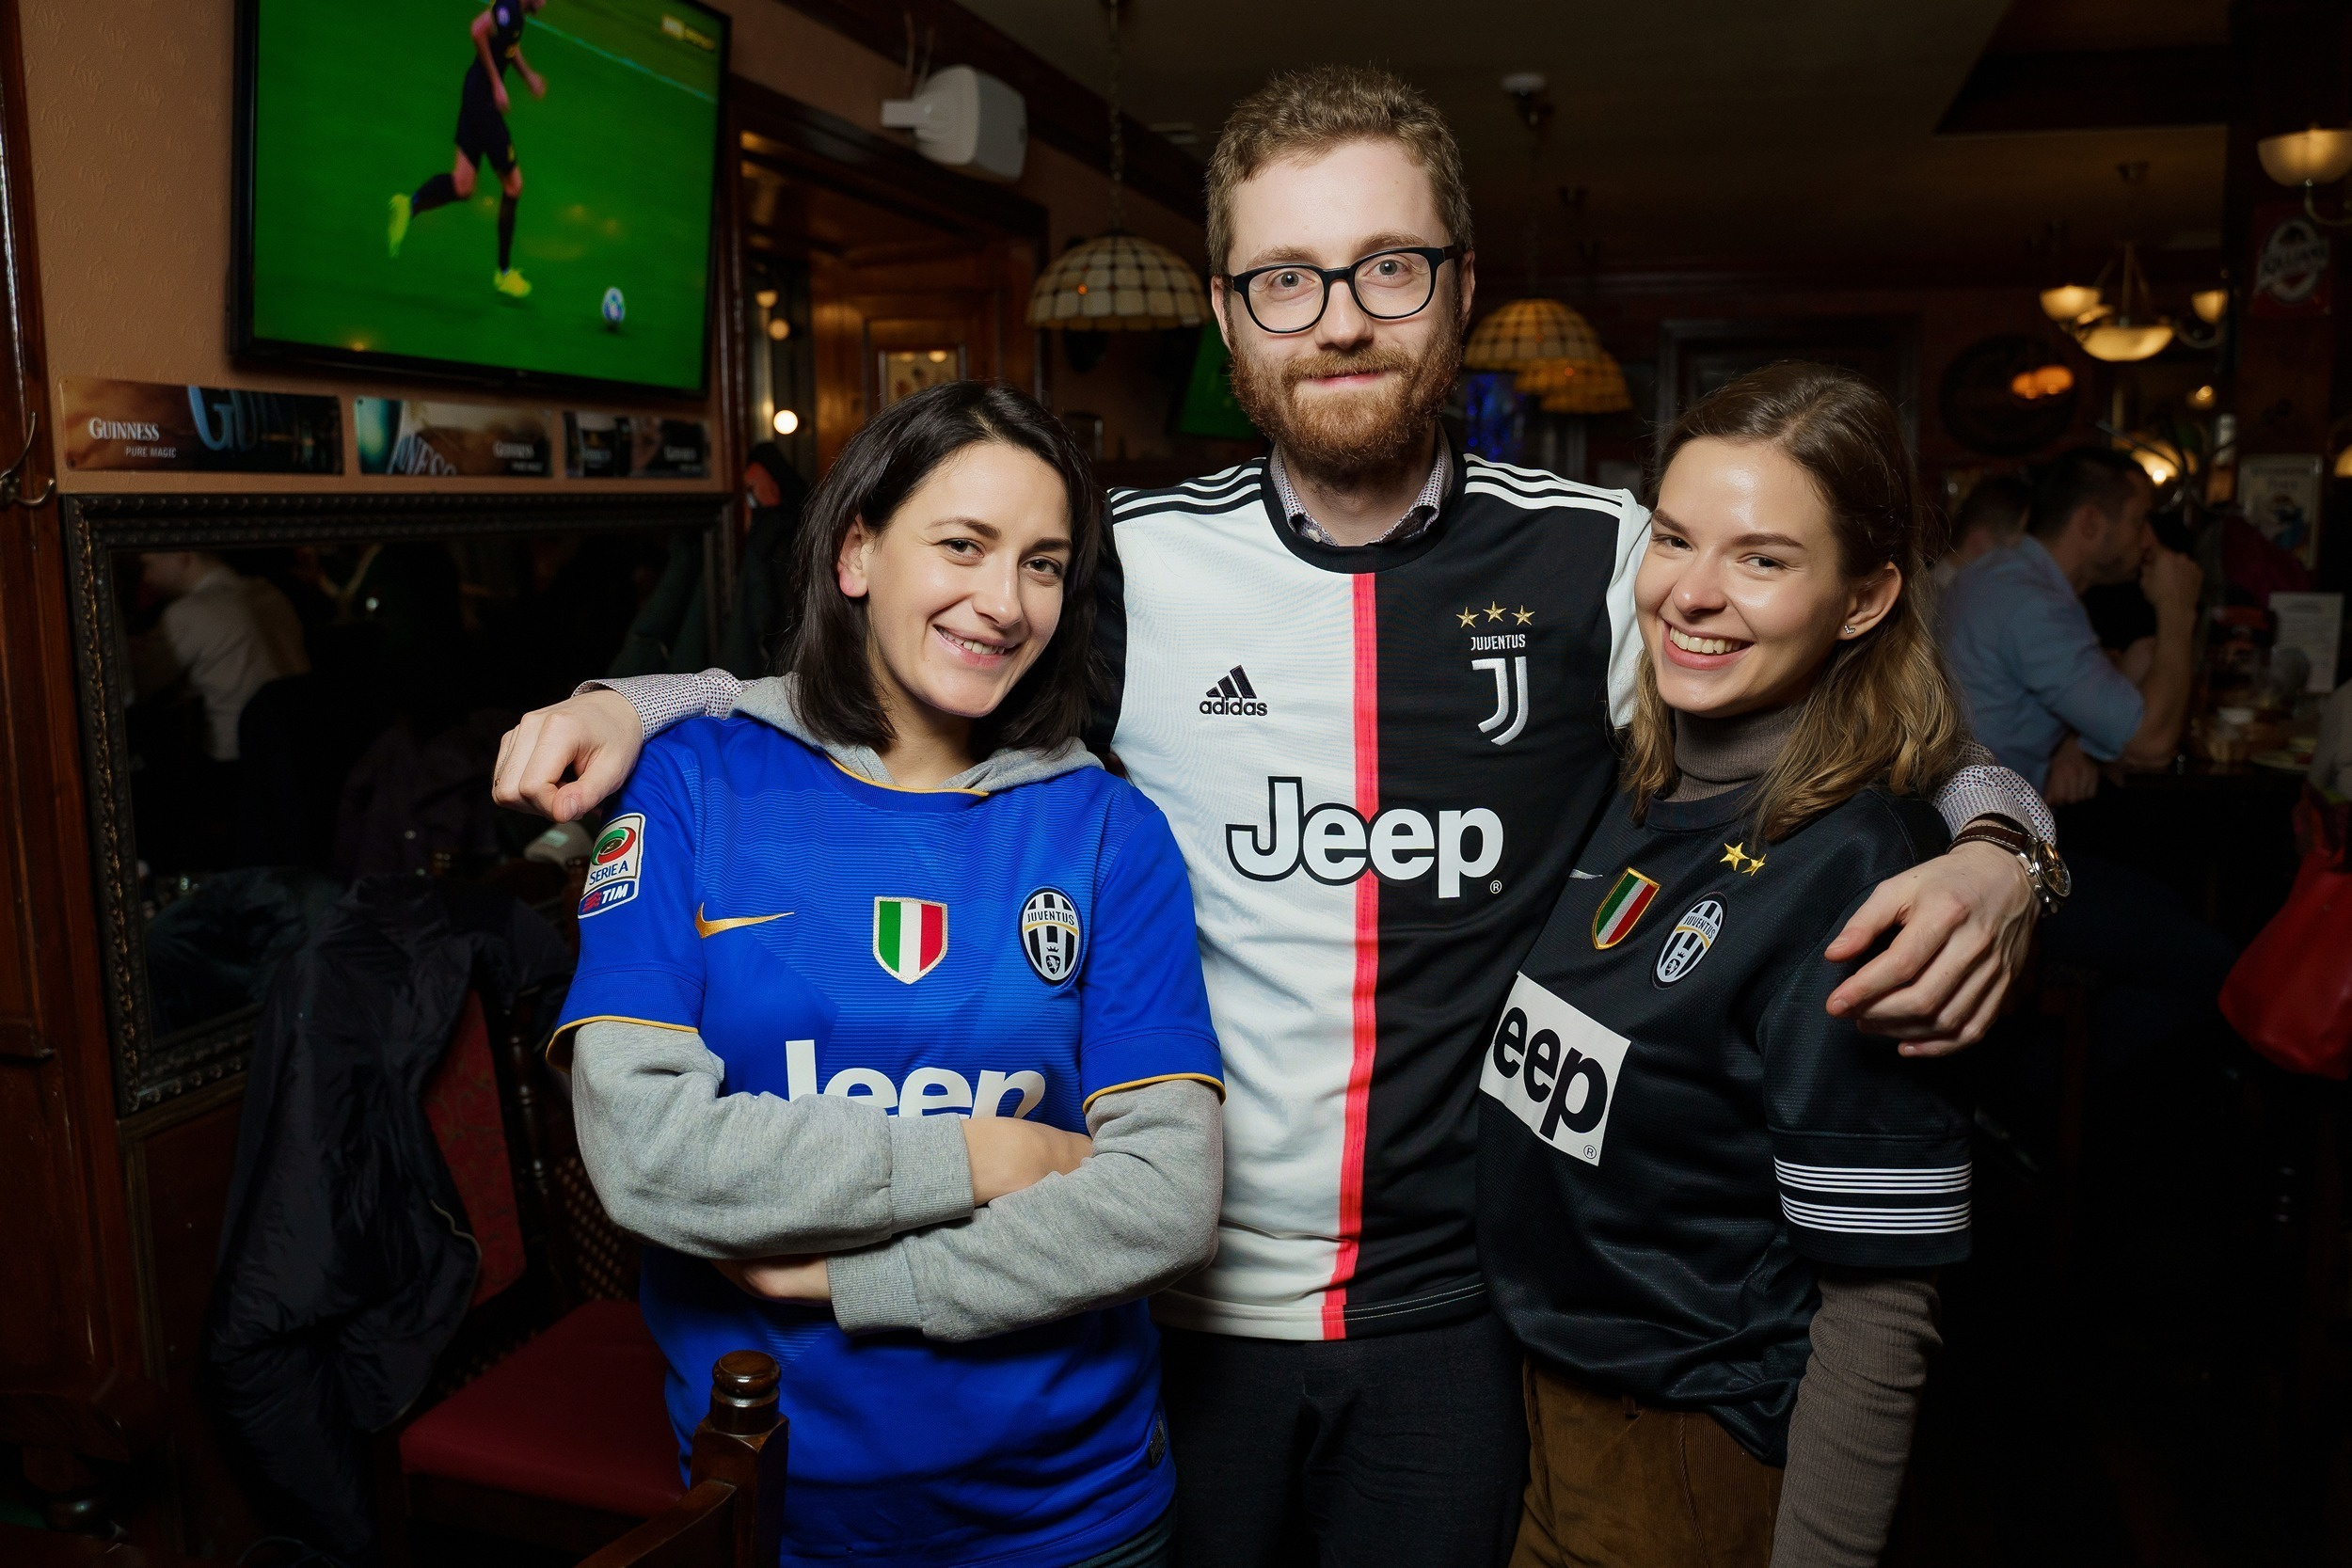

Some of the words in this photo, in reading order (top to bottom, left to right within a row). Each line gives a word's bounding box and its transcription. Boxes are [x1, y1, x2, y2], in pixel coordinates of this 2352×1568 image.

[88, 417, 160, 442] GUINNESS
[125, 446, 148, 457] PURE
[150, 447, 177, 459] MAGIC
[1470, 634, 1526, 651] JUVENTUS
[1199, 696, 1268, 716] adidas
[1225, 775, 1504, 899] Jeep
[589, 863, 618, 885] SERIE
[618, 860, 629, 873] A
[602, 883, 629, 904] TIM
[1026, 911, 1075, 926] JUVENTUS
[1682, 913, 1716, 940] JUVENTUS
[1492, 1006, 1609, 1142] eep
